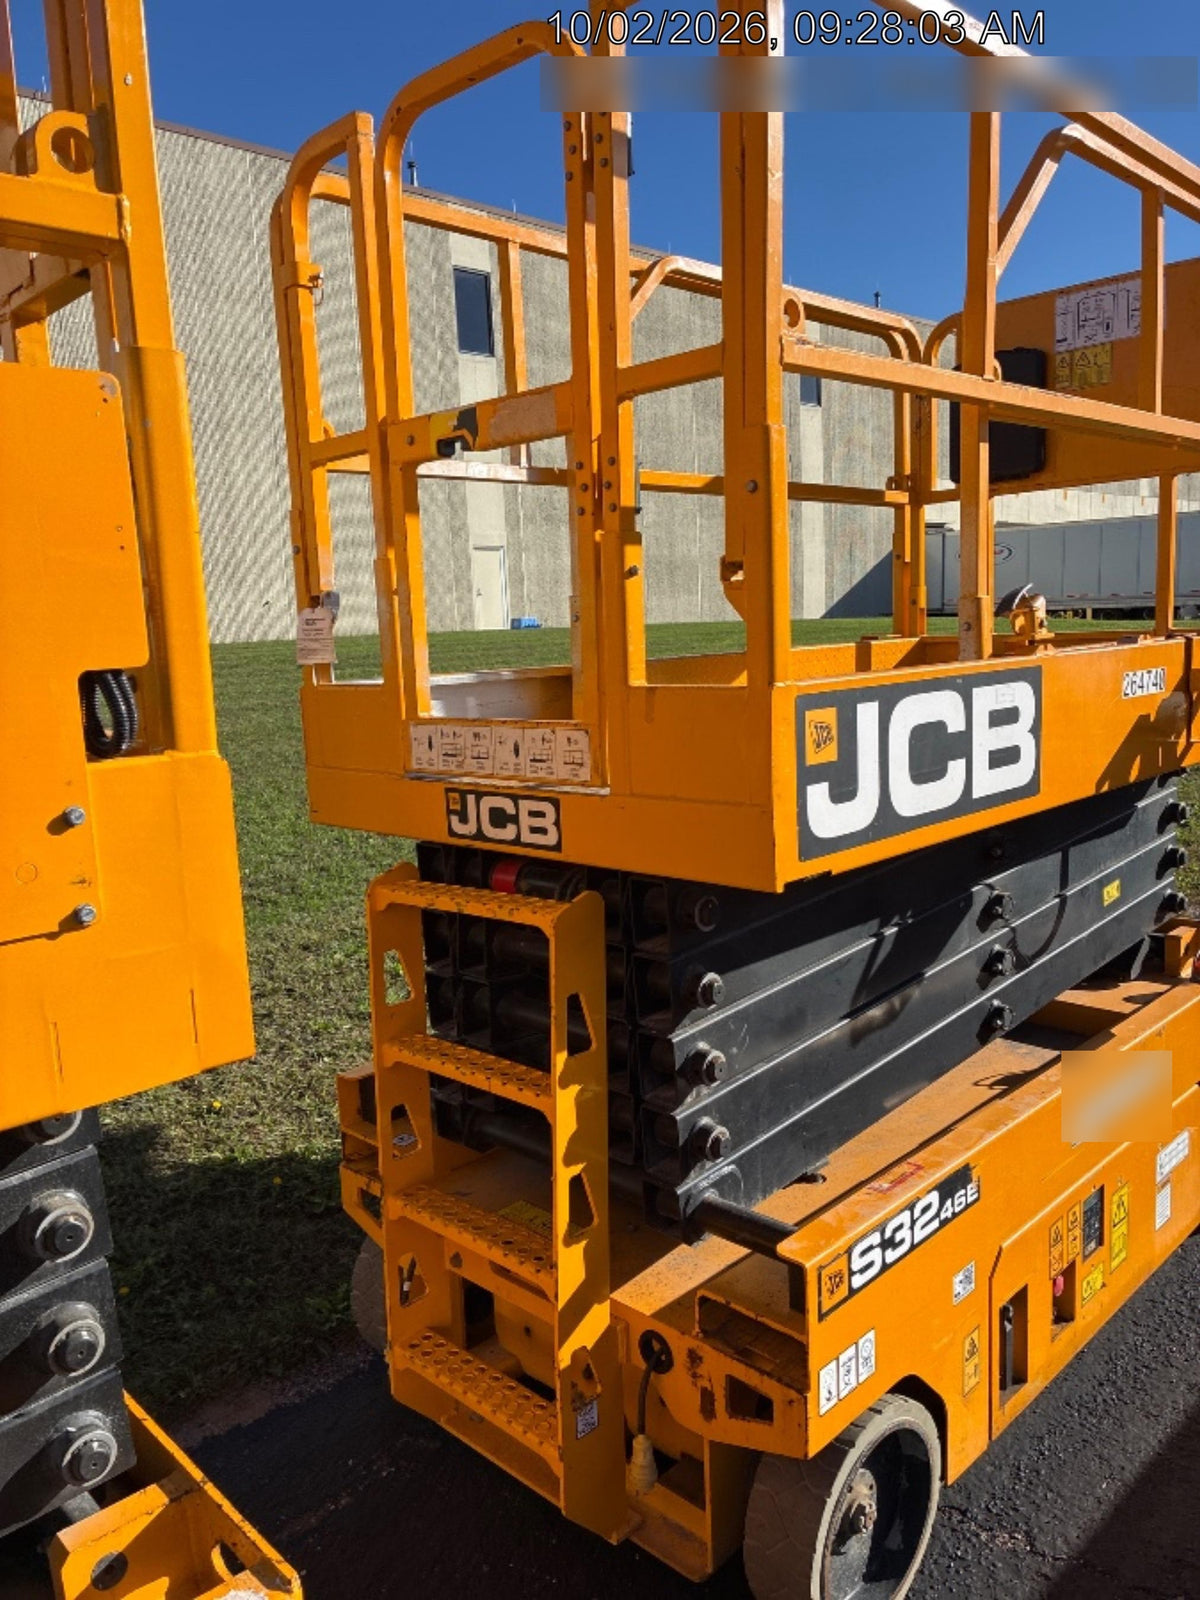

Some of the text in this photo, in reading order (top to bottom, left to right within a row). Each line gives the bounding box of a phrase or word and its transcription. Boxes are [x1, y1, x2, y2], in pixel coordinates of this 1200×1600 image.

[1123, 668, 1166, 697] 264740
[806, 681, 1036, 838] JCB
[449, 794, 559, 846] JCB
